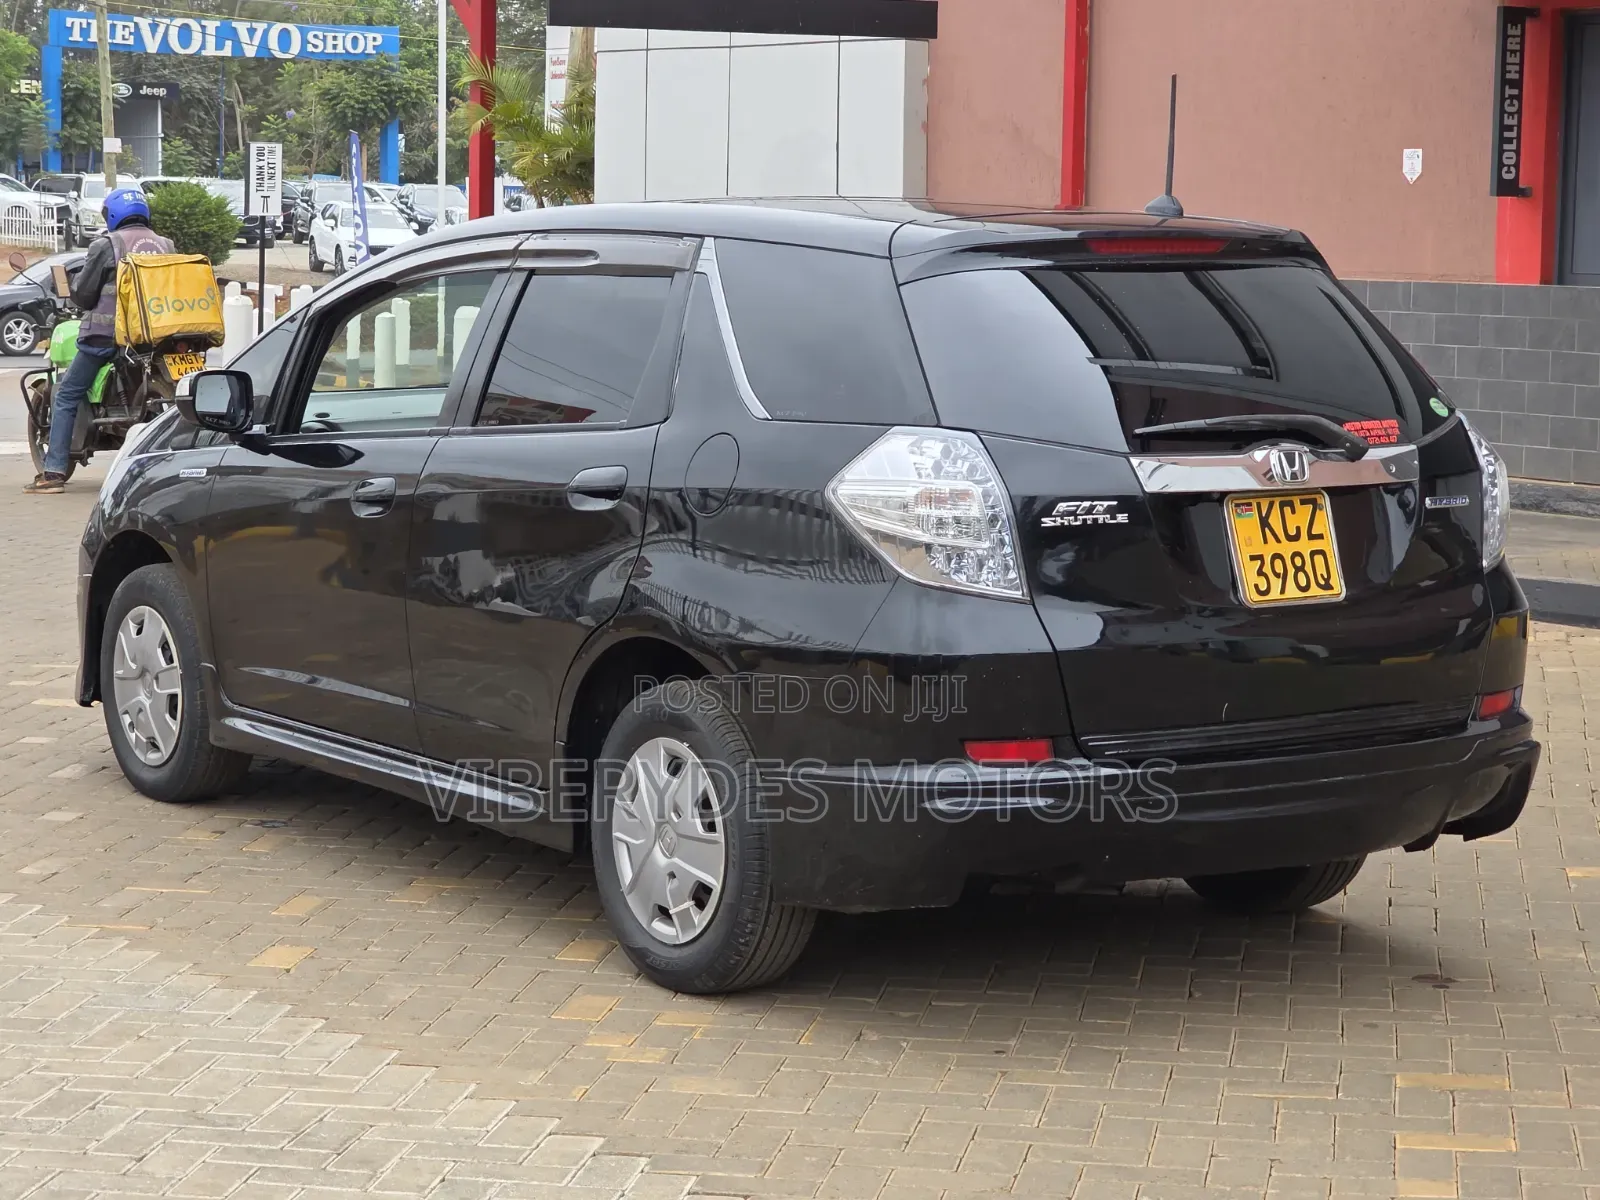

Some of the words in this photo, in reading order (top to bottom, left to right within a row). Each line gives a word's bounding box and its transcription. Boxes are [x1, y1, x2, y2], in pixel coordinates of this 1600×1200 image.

[66, 17, 135, 45] THE
[133, 16, 302, 59] VOLVO
[306, 31, 383, 54] SHOP
[1506, 23, 1522, 80] HERE
[139, 85, 167, 97] Jeep
[1502, 85, 1519, 180] COLLECT
[256, 146, 266, 163] YOU
[267, 145, 277, 160] TIME
[256, 165, 265, 193] THANK
[267, 161, 277, 181] NEXT
[267, 182, 277, 192] TILL
[147, 294, 210, 315] Glovo
[171, 353, 201, 366] KMGT
[1052, 501, 1118, 516] FIT
[1429, 496, 1468, 507] HYBRID
[1041, 514, 1129, 527] SHUTTLE
[1256, 498, 1325, 544] KCZ
[1249, 549, 1335, 597] 398Q
